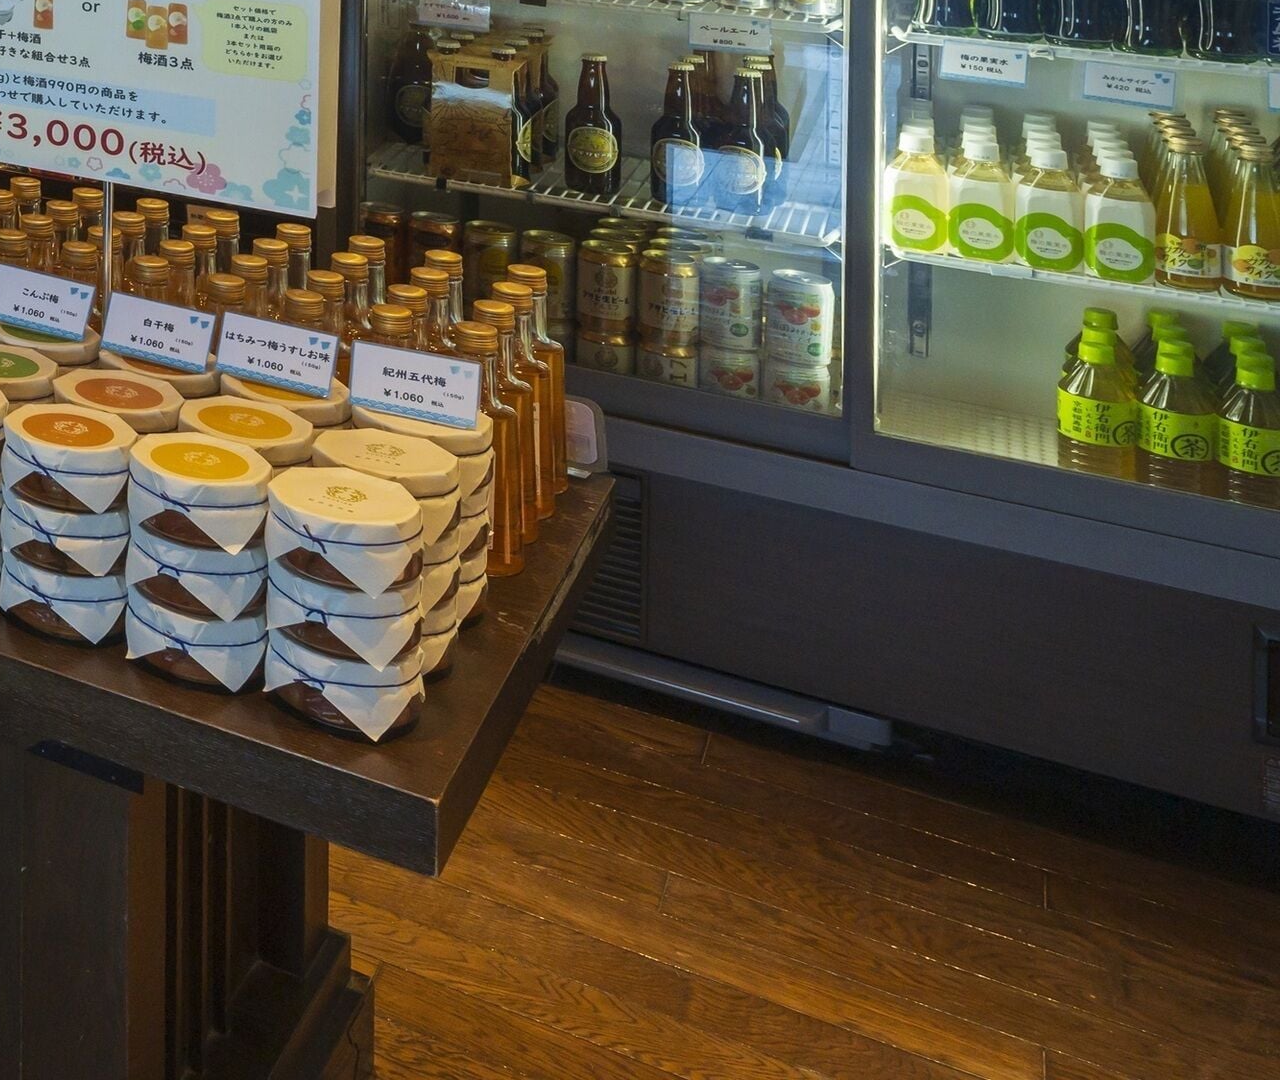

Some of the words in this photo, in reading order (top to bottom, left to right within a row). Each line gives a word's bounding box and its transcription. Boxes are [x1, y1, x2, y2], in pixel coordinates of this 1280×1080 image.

[82, 0, 101, 13] or
[243, 33, 265, 41] または
[138, 51, 195, 71] 梅酒3点
[960, 52, 1008, 66] 梅の果実水
[960, 63, 984, 72] ¥150
[1102, 73, 1156, 87] みかんサイダー
[1107, 83, 1131, 93] ¥420
[22, 287, 59, 305] こんぶ梅
[143, 317, 176, 333] 白干梅
[225, 330, 331, 363] はちみつ梅うすしお味
[382, 365, 447, 388] 紀州五代梅
[1094, 401, 1111, 445] 伊右衛門
[1153, 410, 1169, 455] 伊右衛門
[1179, 437, 1206, 460] 茶
[1242, 426, 1259, 471] 伊右衛門
